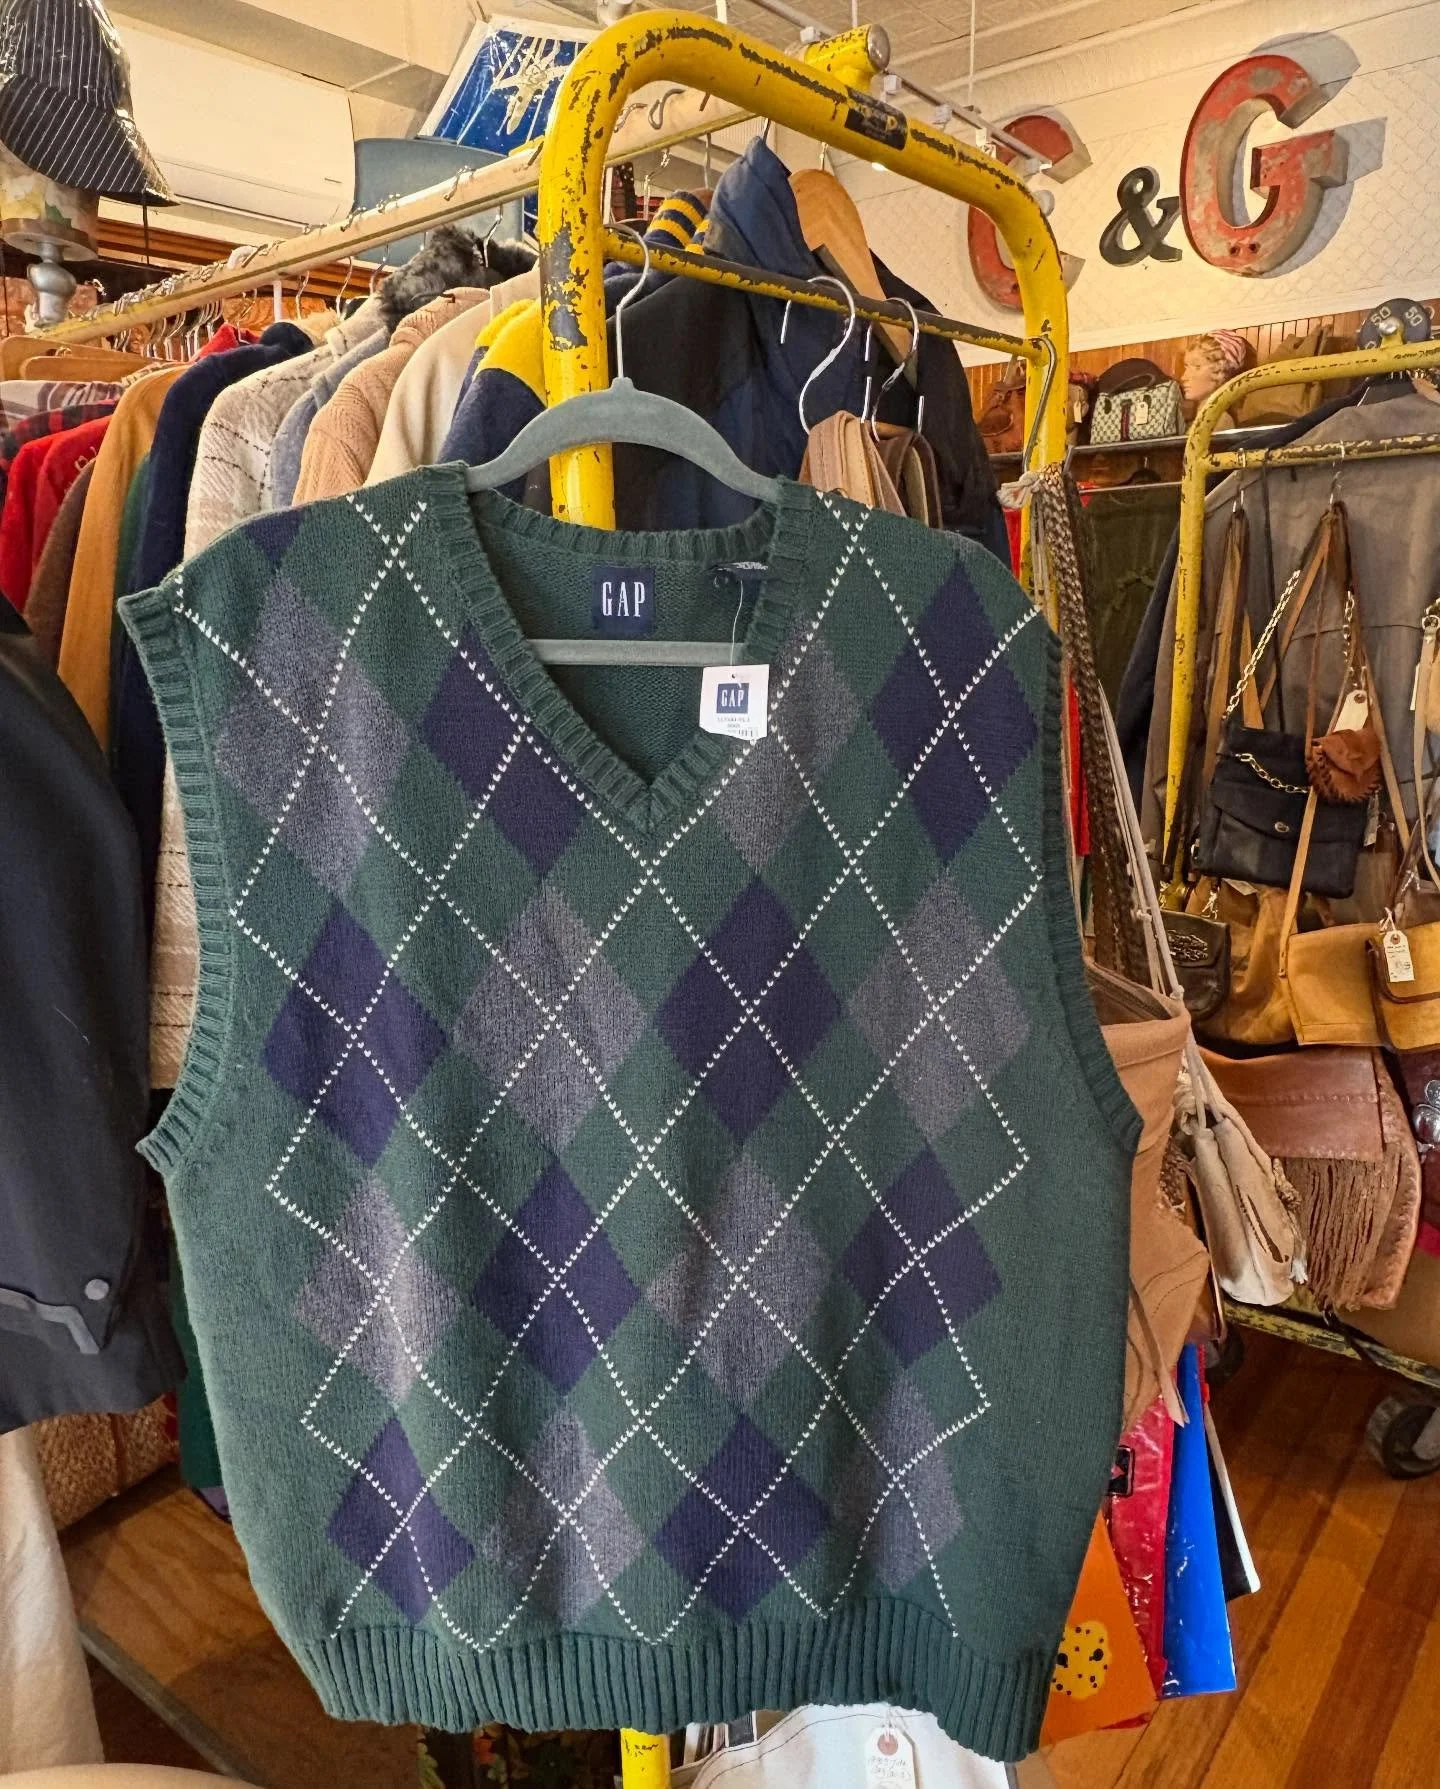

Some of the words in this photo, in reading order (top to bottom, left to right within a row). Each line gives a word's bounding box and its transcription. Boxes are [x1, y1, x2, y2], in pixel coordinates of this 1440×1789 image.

[1099, 165, 1182, 267] &
[1180, 54, 1350, 279] G
[602, 581, 646, 618] GAP
[721, 689, 745, 708] GAP
